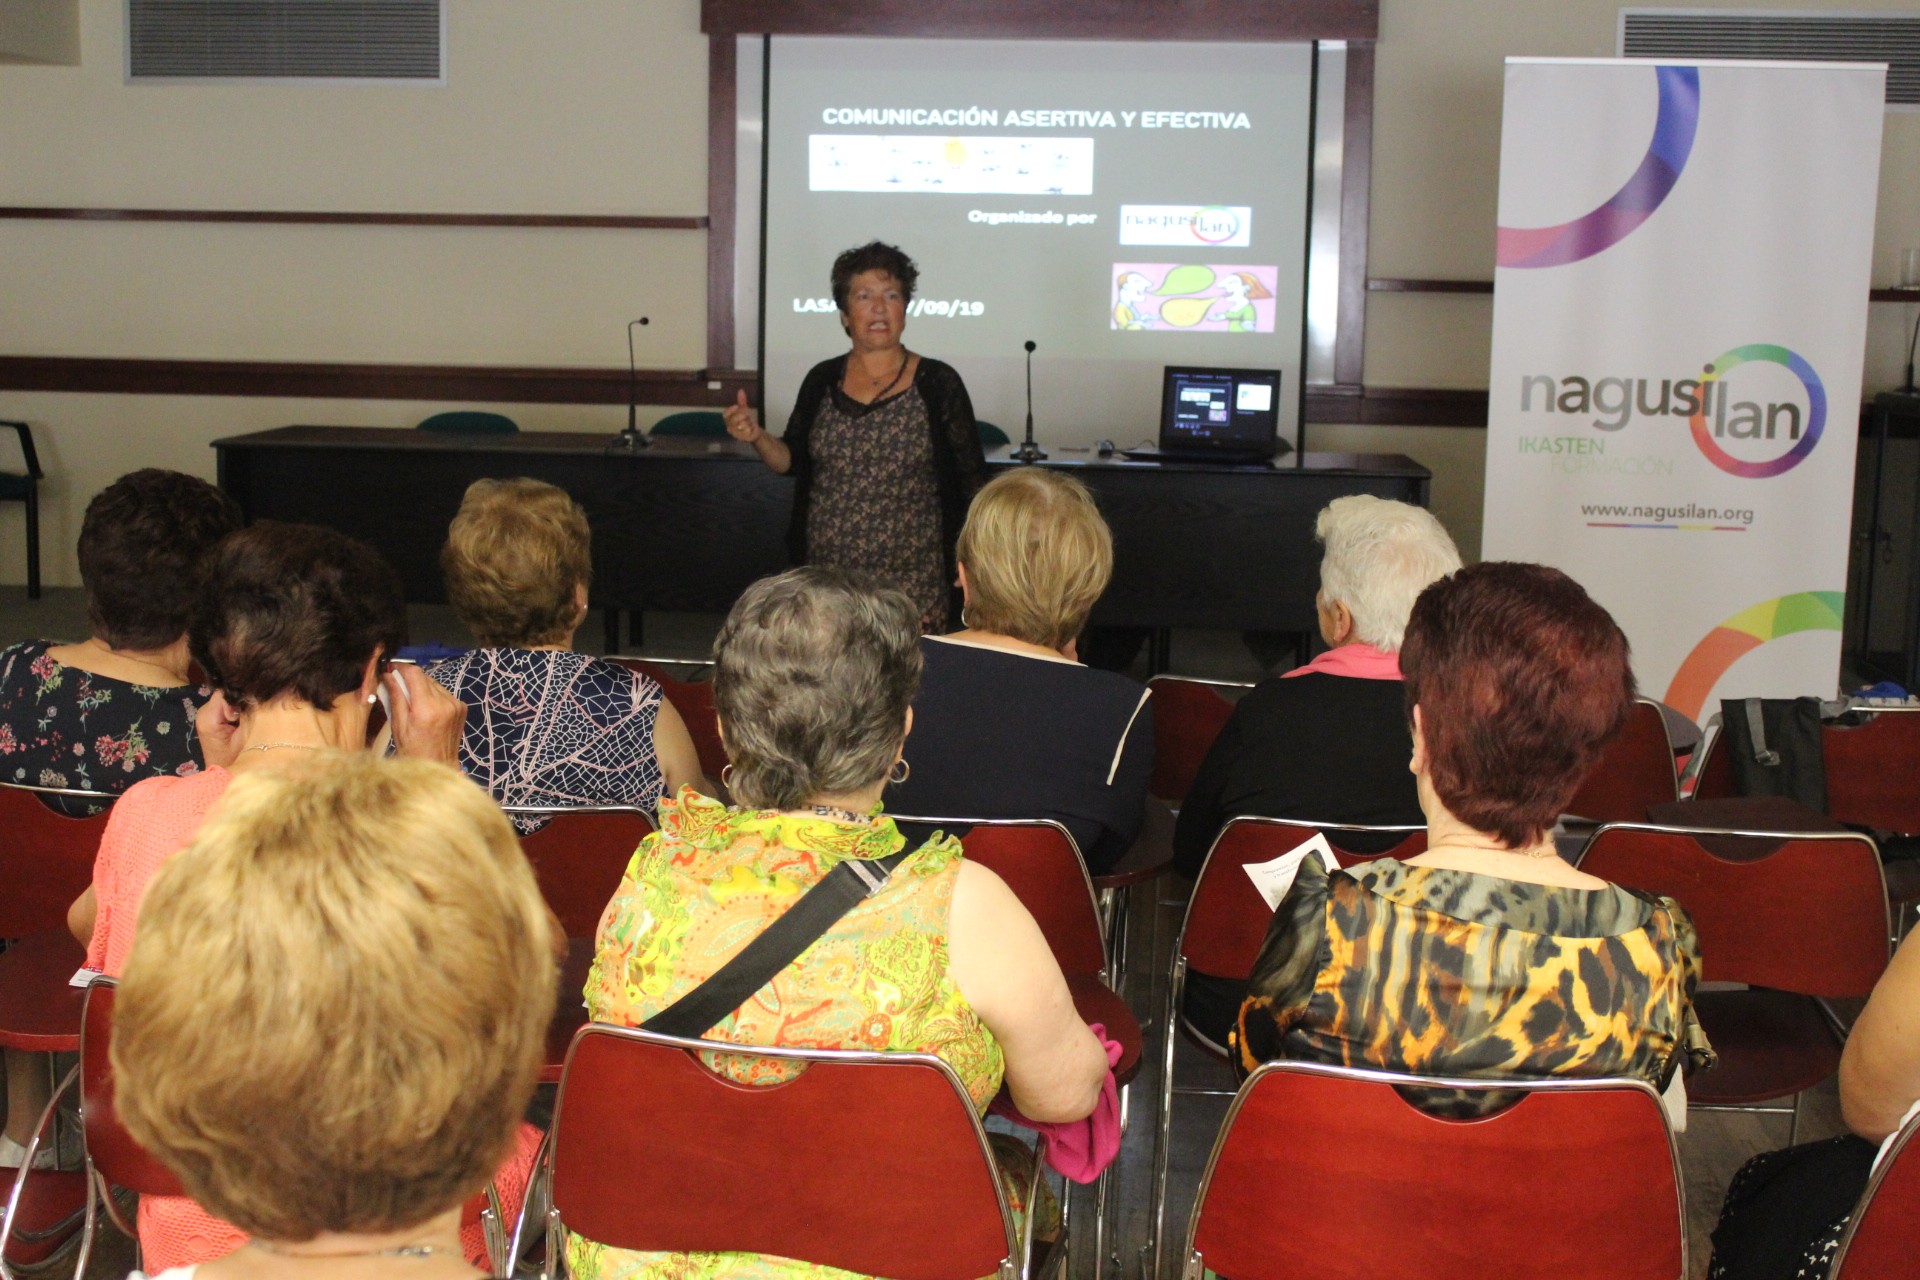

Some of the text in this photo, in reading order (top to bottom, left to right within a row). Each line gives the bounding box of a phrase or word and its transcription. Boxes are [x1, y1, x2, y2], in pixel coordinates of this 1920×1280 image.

[823, 106, 1251, 129] COMUNICACIÓN ASERTIVA Y EFECTIVA
[968, 210, 1097, 226] Organizado por
[1520, 363, 1801, 440] nagusilan
[1518, 436, 1605, 455] IKASTEN
[1581, 504, 1753, 523] www.nagusilan.org
